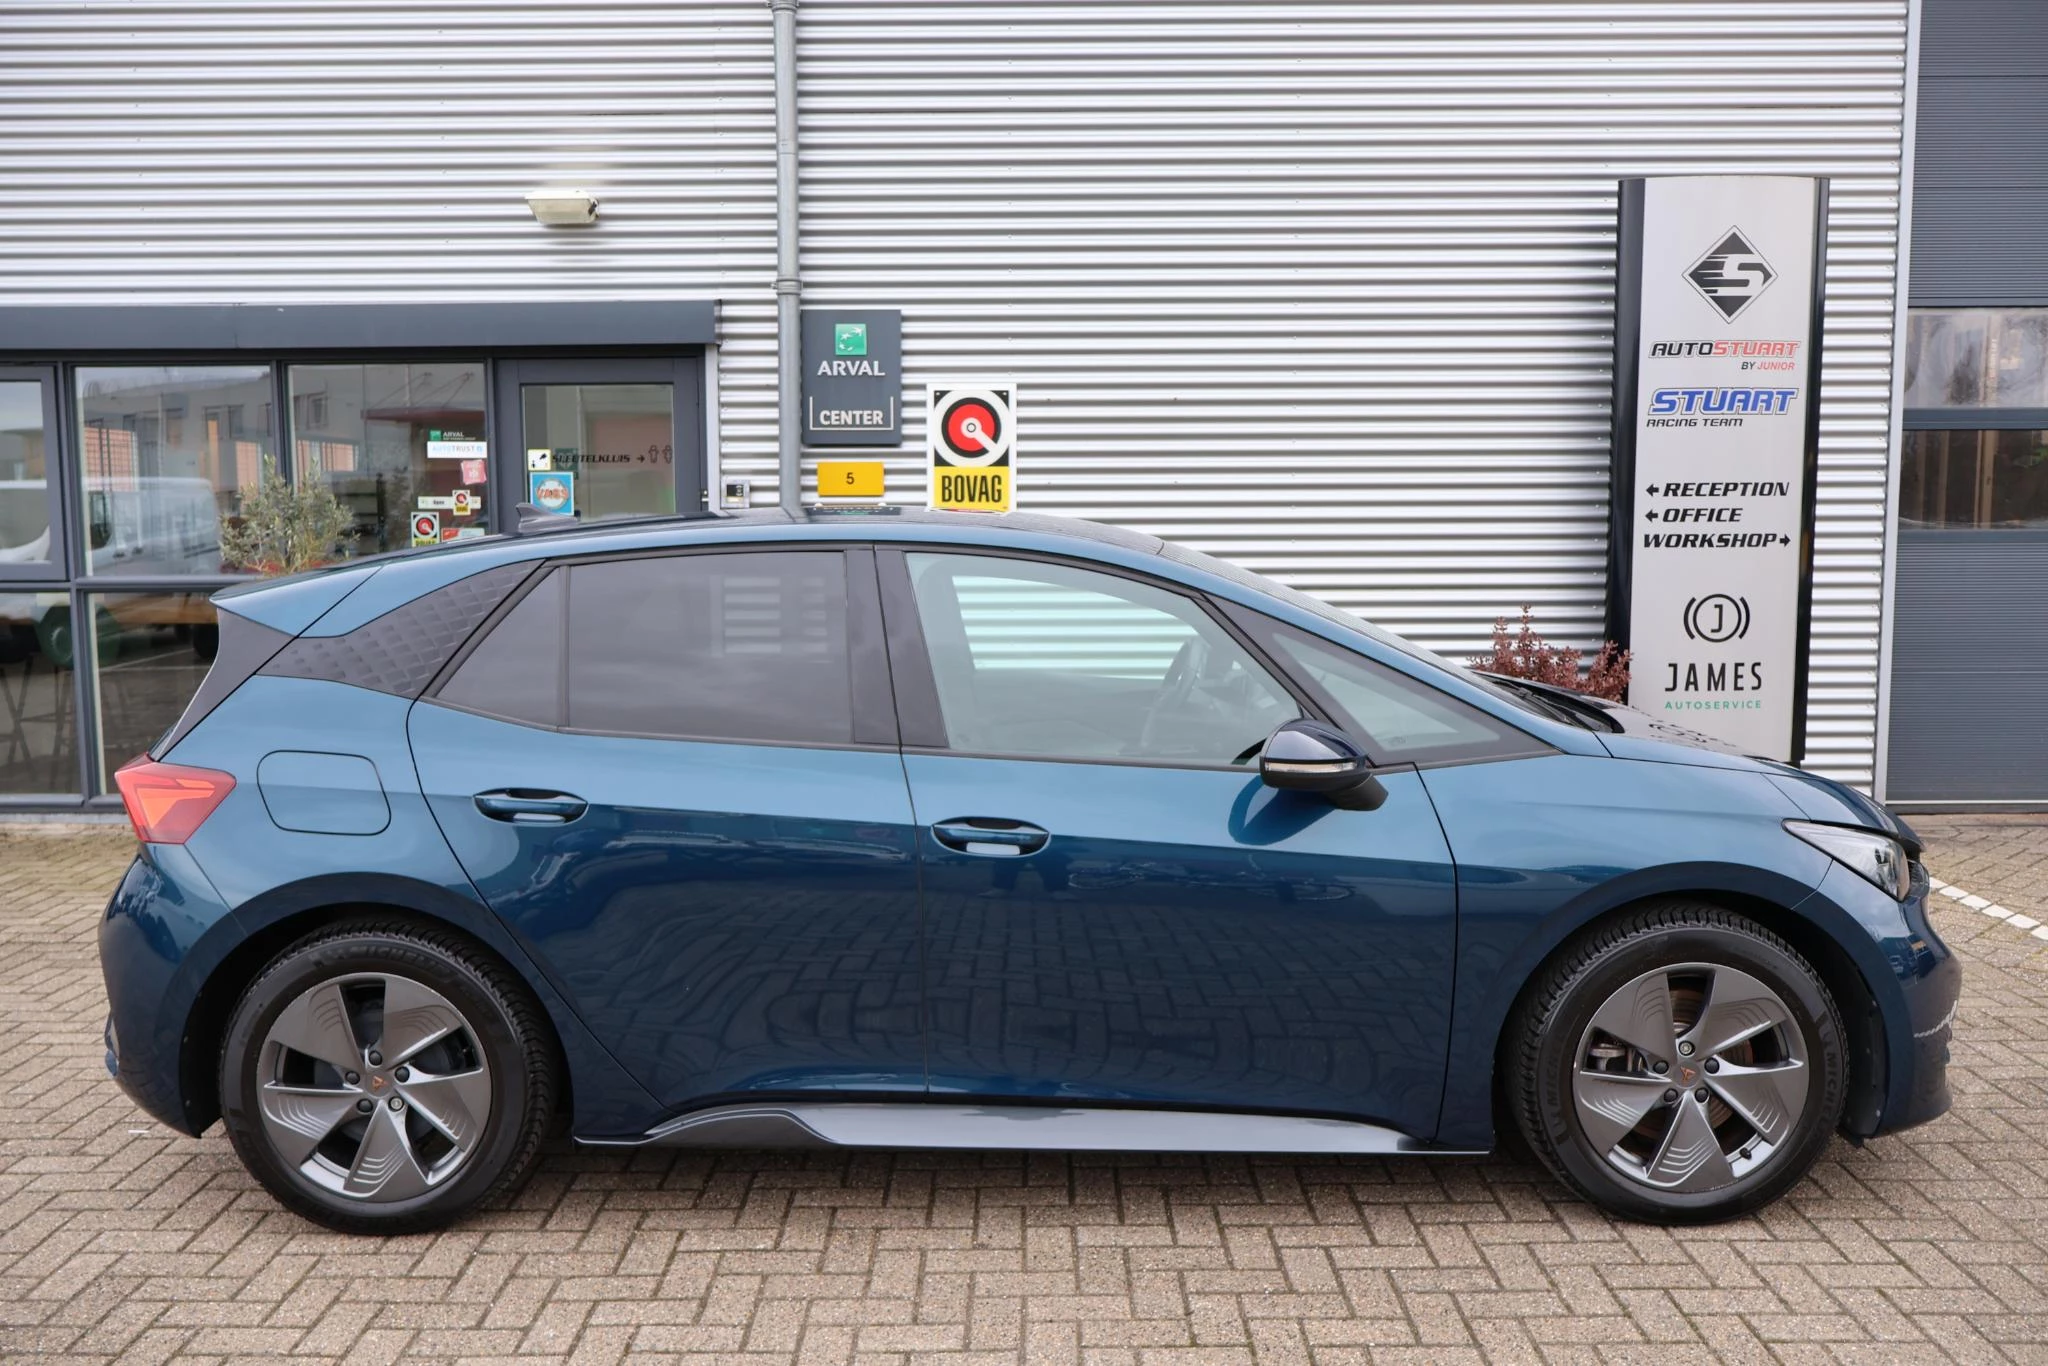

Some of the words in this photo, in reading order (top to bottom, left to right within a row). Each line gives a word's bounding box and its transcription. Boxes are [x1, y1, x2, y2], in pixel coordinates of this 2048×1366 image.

[1650, 341, 1800, 358] AUTOSTUART
[817, 360, 886, 377] ARVAL
[1741, 361, 1756, 370] BY
[1757, 361, 1795, 370] JUNIOR
[1649, 388, 1800, 415] STUART
[819, 409, 883, 425] CENTER
[1646, 418, 1697, 428] RACING
[1703, 418, 1743, 427] TEAM
[845, 472, 855, 485] 5
[941, 475, 1002, 503] BOVAG
[1663, 482, 1790, 497] RECEPTION
[1662, 508, 1744, 522] OFFICE
[1643, 533, 1777, 548] WORKSHOP
[1664, 662, 1762, 692] JAMES
[1664, 700, 1761, 710] AUTOSERVICE
